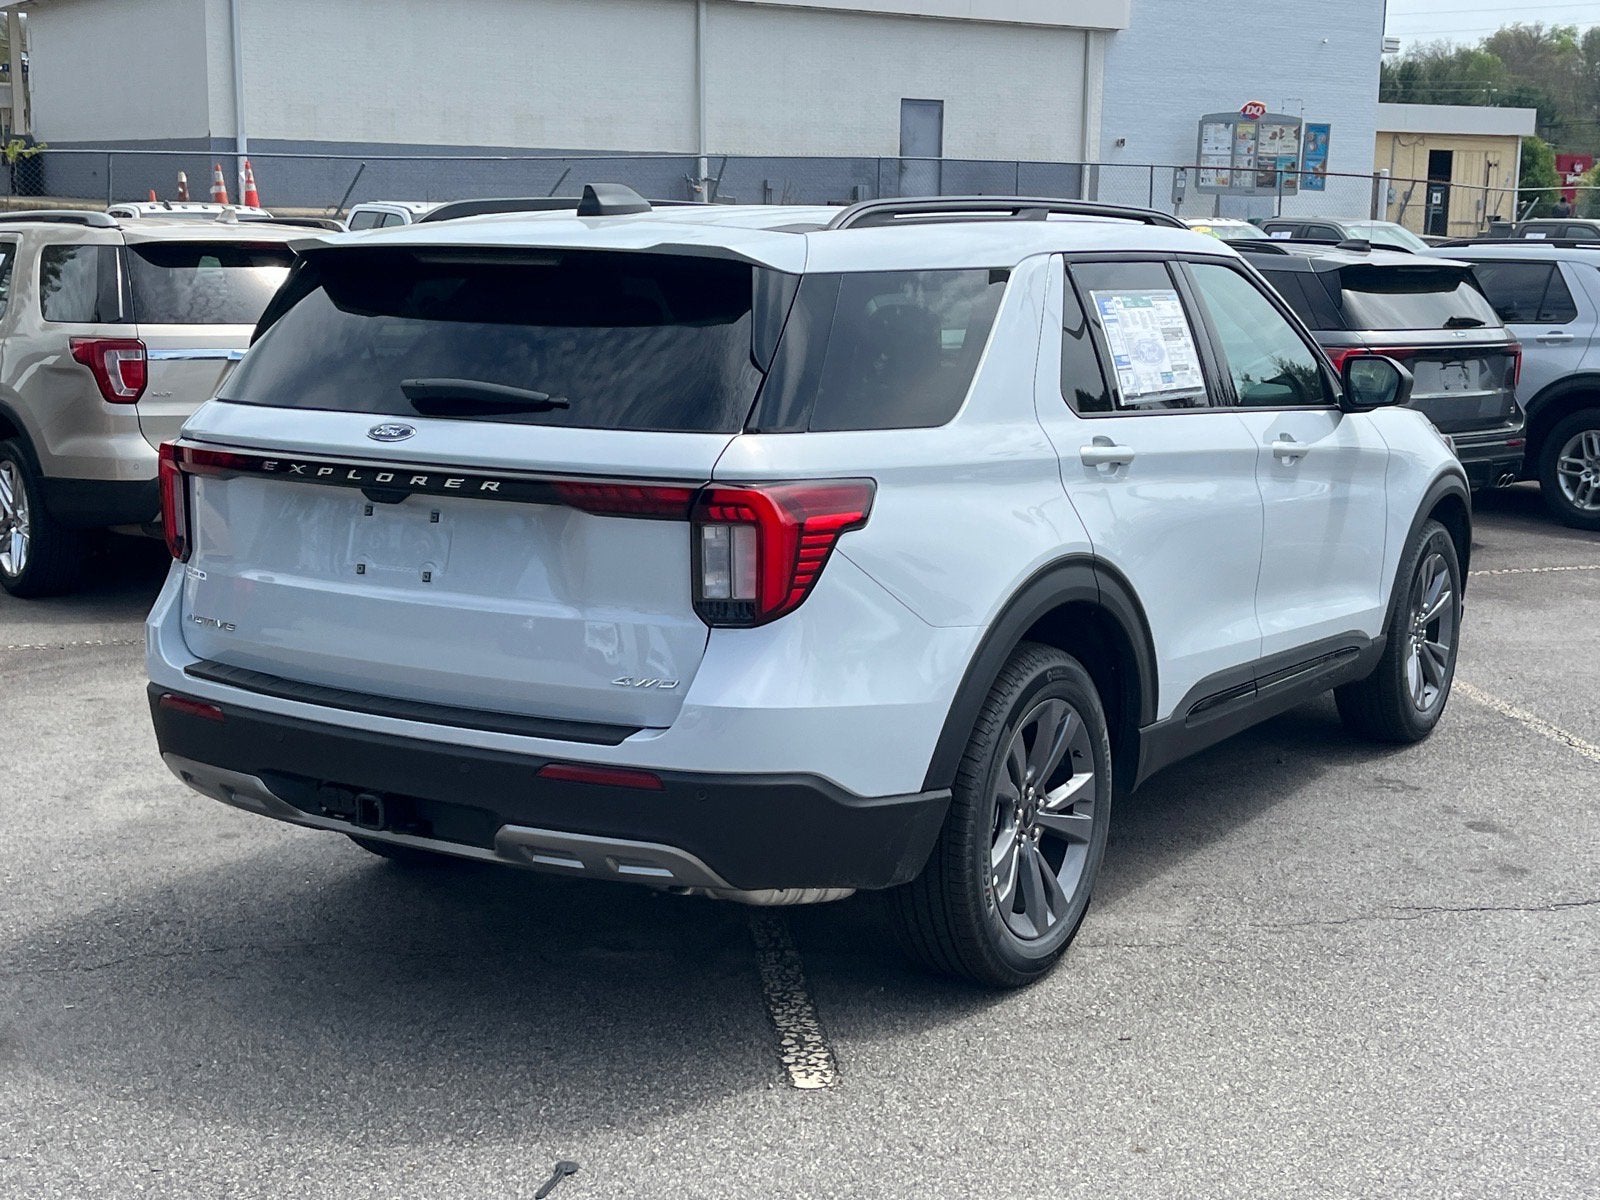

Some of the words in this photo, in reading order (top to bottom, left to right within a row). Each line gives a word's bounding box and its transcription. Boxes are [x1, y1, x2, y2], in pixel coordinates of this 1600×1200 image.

[1245, 105, 1263, 116] DQ
[372, 424, 408, 438] Ford
[261, 460, 502, 493] EXPLORER
[611, 676, 680, 689] 4WD
